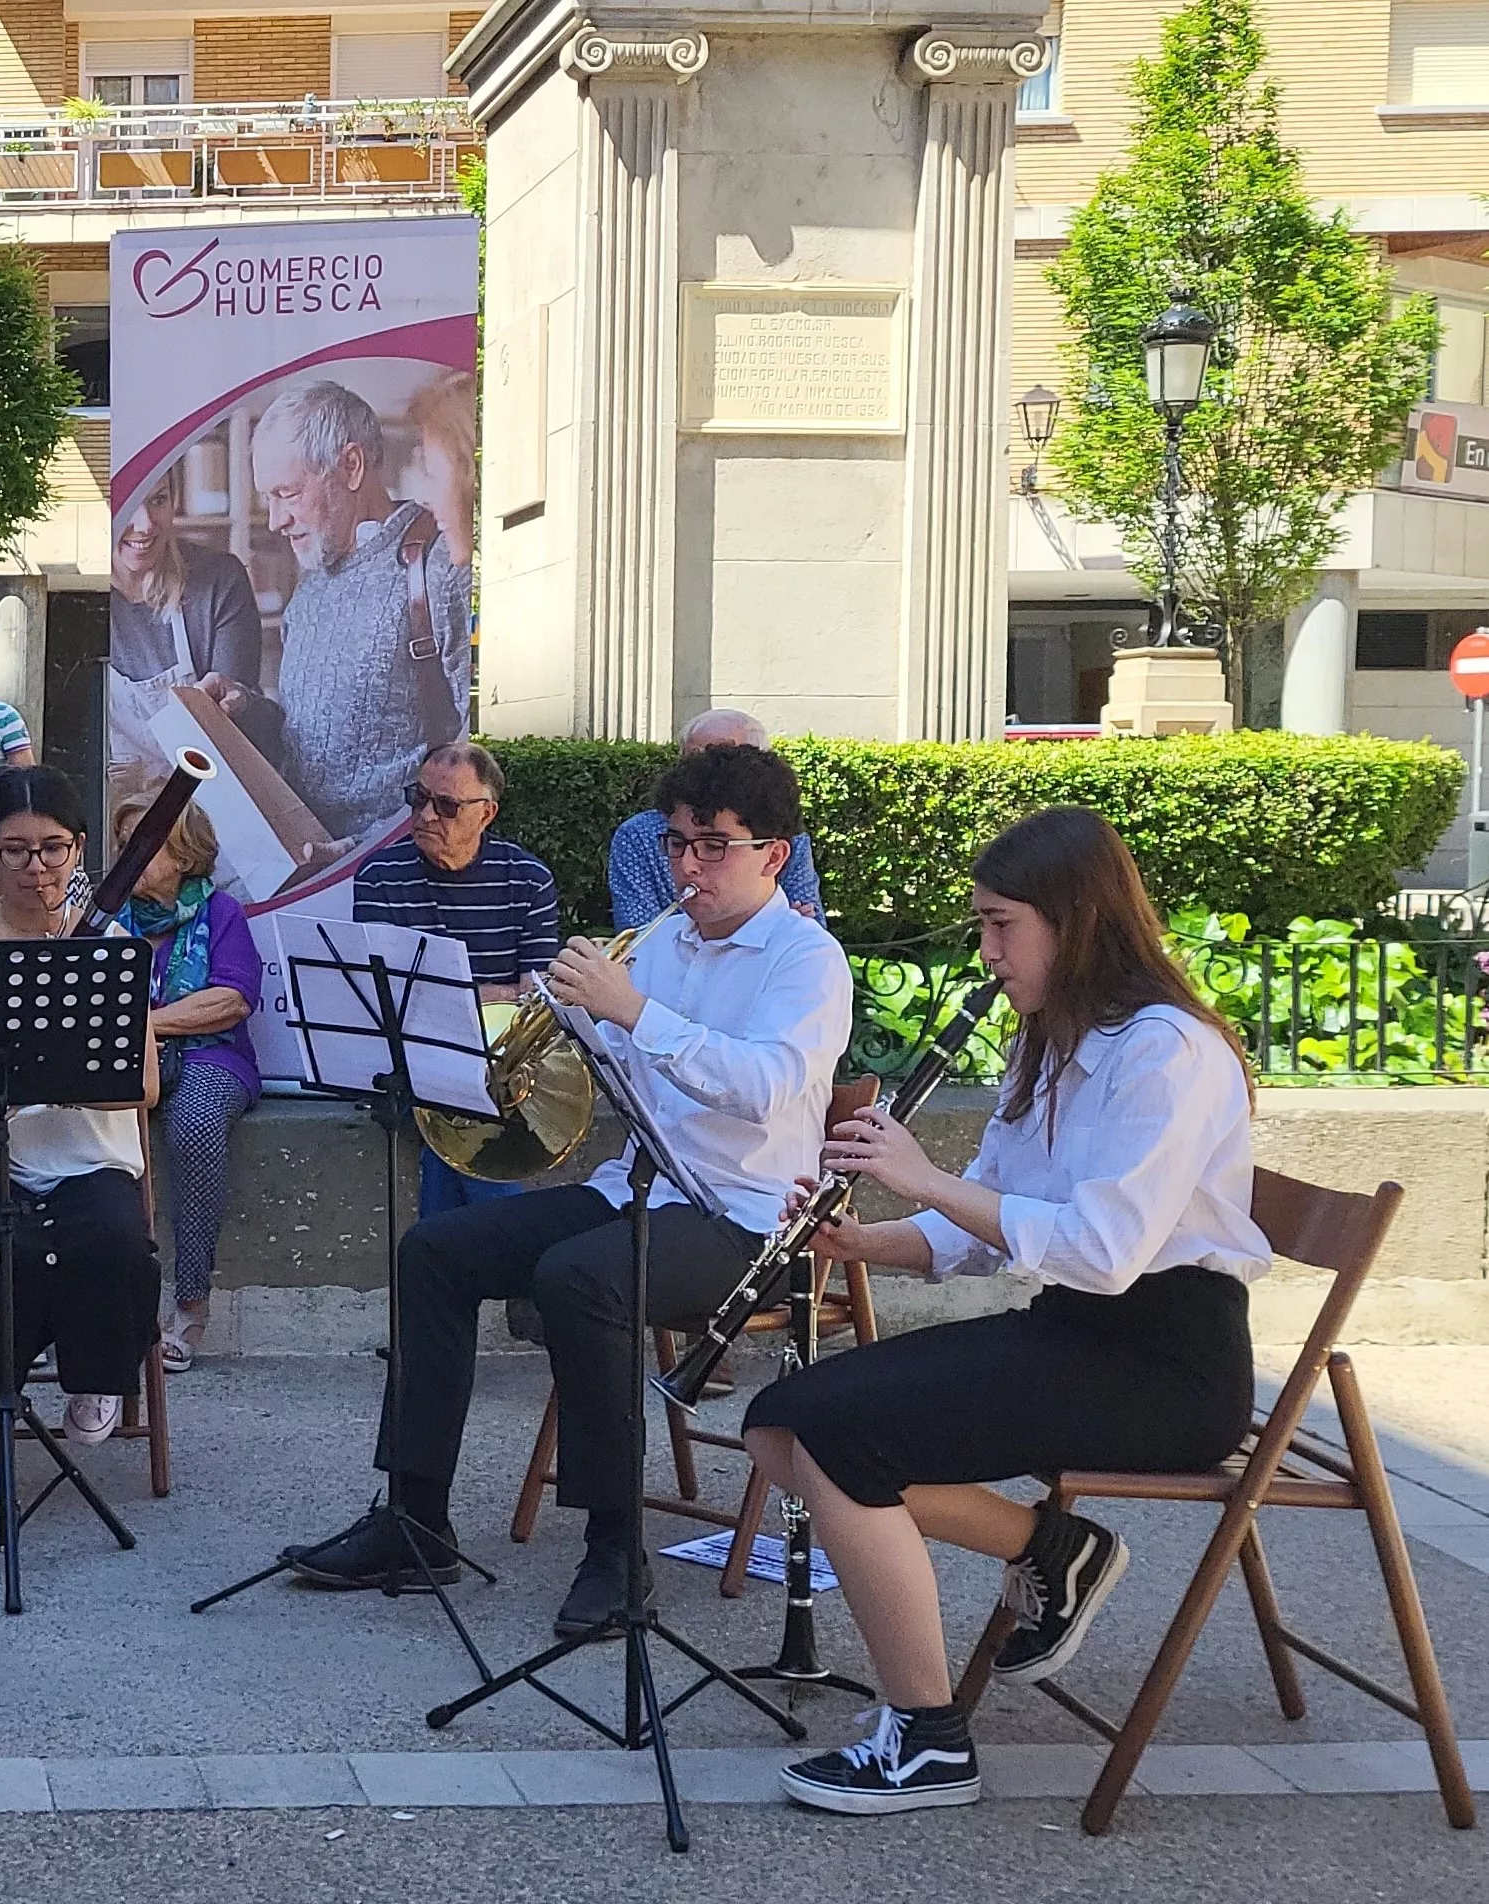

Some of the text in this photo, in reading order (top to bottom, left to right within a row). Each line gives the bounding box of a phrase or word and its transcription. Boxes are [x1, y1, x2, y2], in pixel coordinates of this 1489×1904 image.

[215, 254, 383, 285] COMERCIO
[215, 282, 382, 317] HUESCA
[750, 318, 766, 331] EL
[759, 335, 812, 349] RODRIGO
[760, 352, 777, 365] DE
[836, 404, 853, 417] DE
[1465, 440, 1489, 467] En
